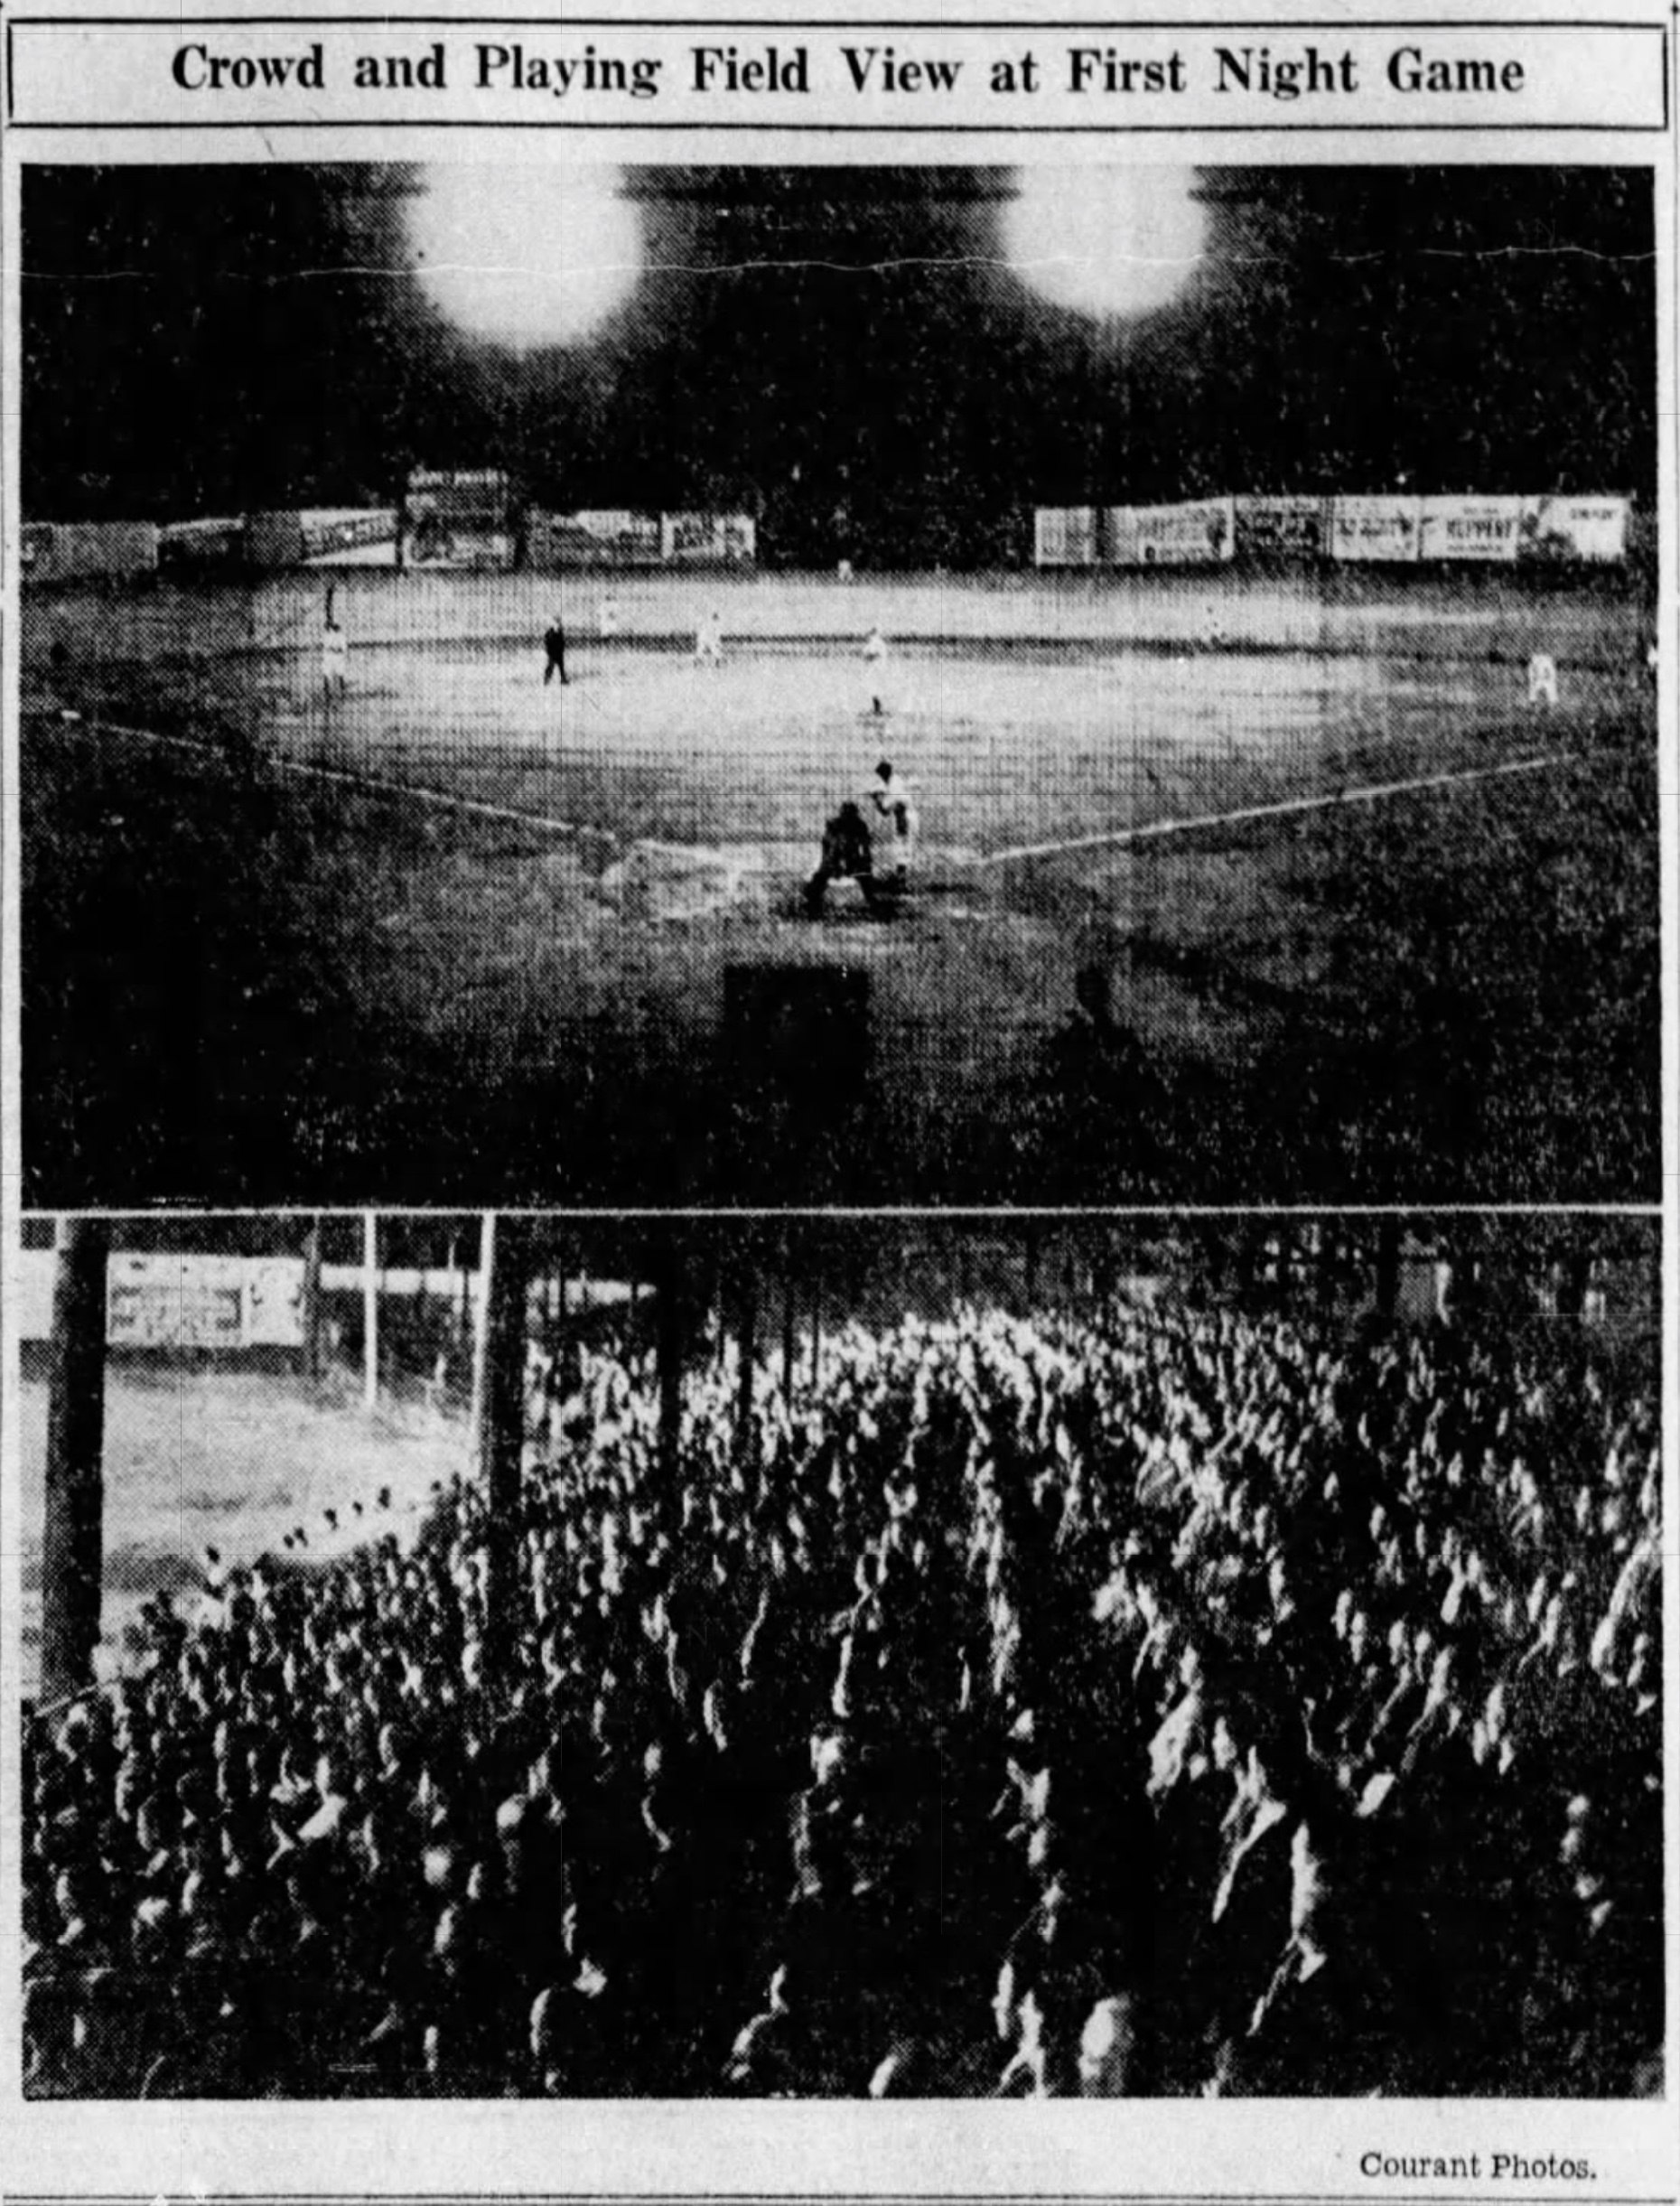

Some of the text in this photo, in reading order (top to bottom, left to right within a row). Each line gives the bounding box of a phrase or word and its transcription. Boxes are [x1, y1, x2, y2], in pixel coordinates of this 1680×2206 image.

[172, 42, 1525, 99] Crowd and Playing Field View at First Night Game
[1359, 2151, 1597, 2180] Courant Photos.
